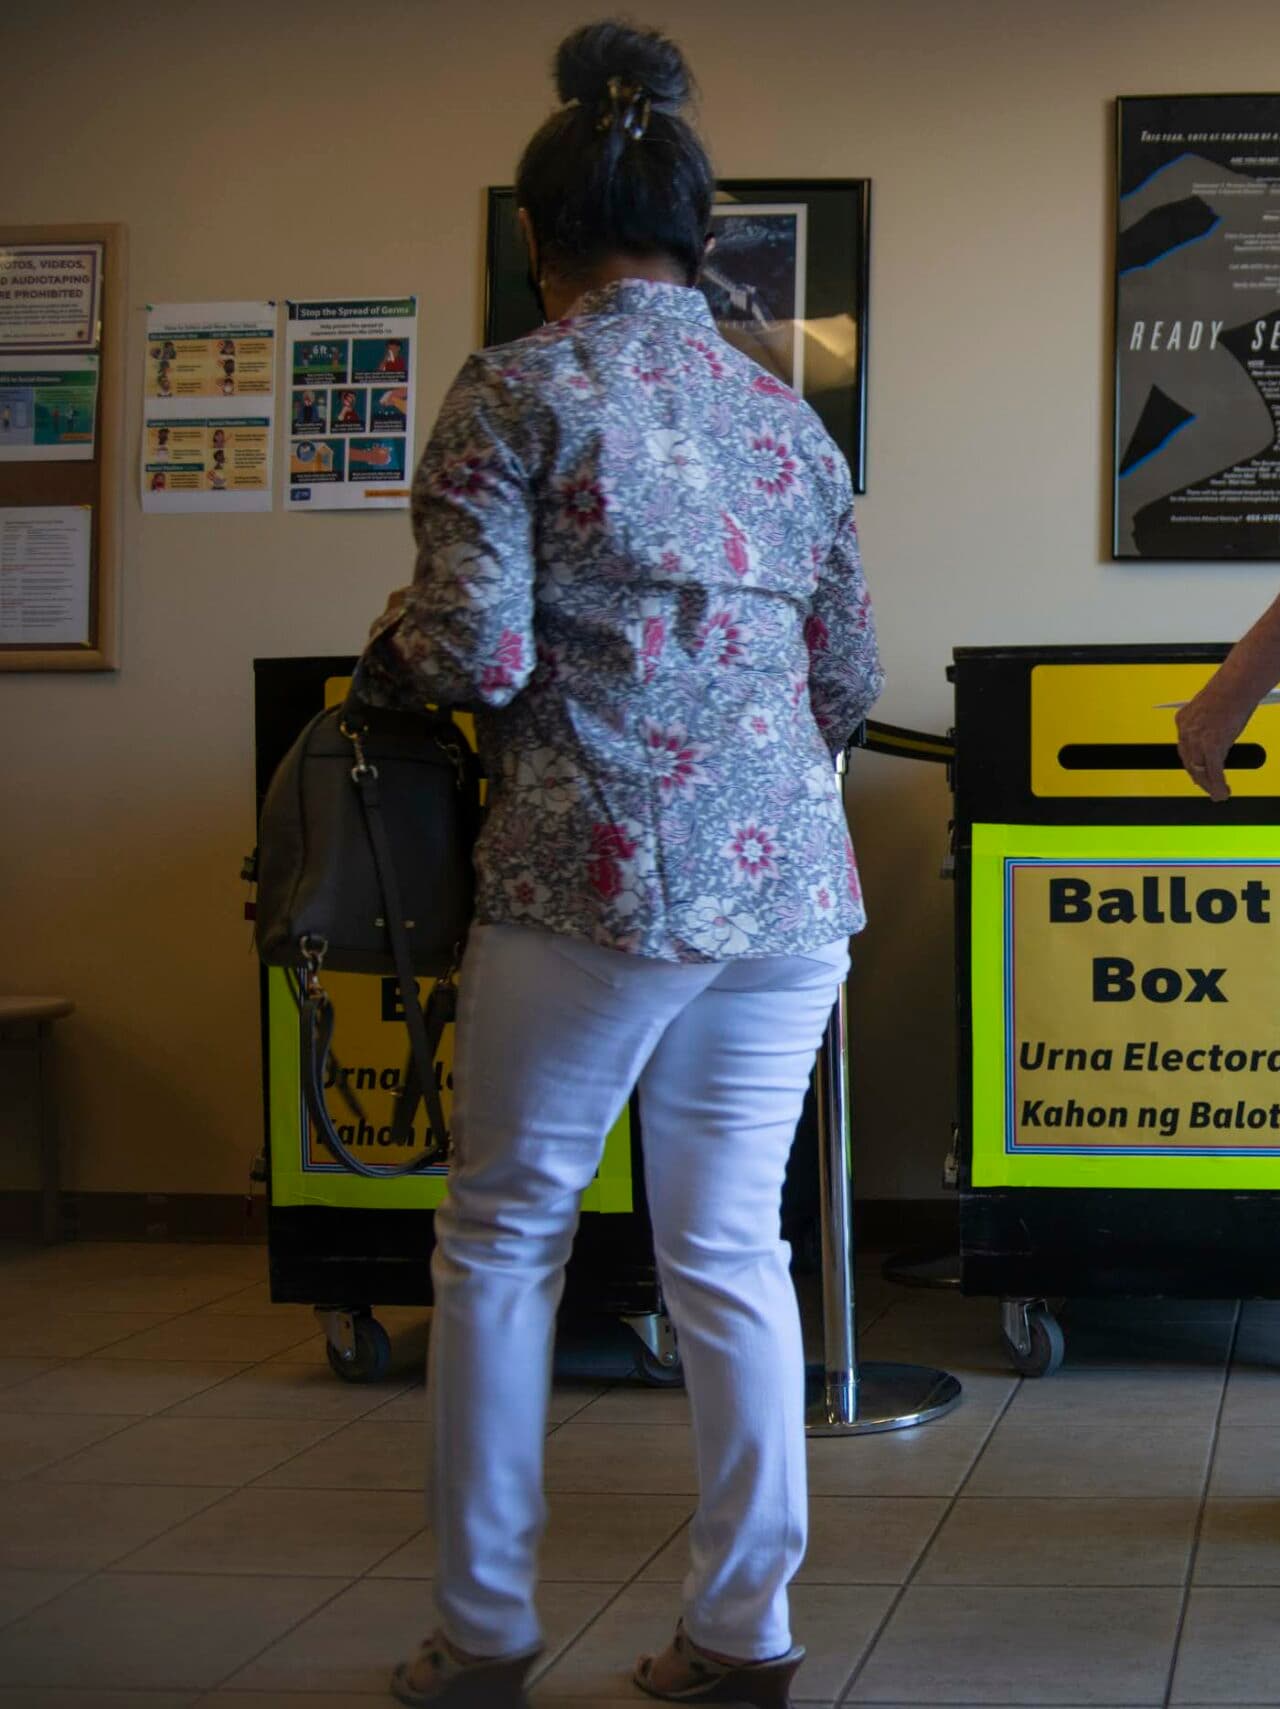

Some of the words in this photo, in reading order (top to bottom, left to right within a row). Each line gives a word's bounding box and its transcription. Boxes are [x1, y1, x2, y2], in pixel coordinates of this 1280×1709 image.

[0, 260, 36, 271] OTOS,
[11, 275, 90, 285] AUDIOTAPING
[14, 289, 83, 299] PROHIBITED
[300, 308, 321, 319] Stop
[322, 307, 336, 316] the
[337, 306, 369, 317] Spread
[370, 306, 380, 314] of
[381, 305, 409, 315] Germs
[312, 345, 319, 354] 6
[319, 345, 328, 354] ft
[1130, 320, 1223, 351] READY
[1049, 876, 1271, 924] Ballot
[1092, 956, 1229, 1003] Box
[1019, 1041, 1112, 1072] Urna
[317, 1118, 415, 1146] aho
[1021, 1100, 1127, 1129] Kahon
[1137, 1106, 1180, 1136] ng
